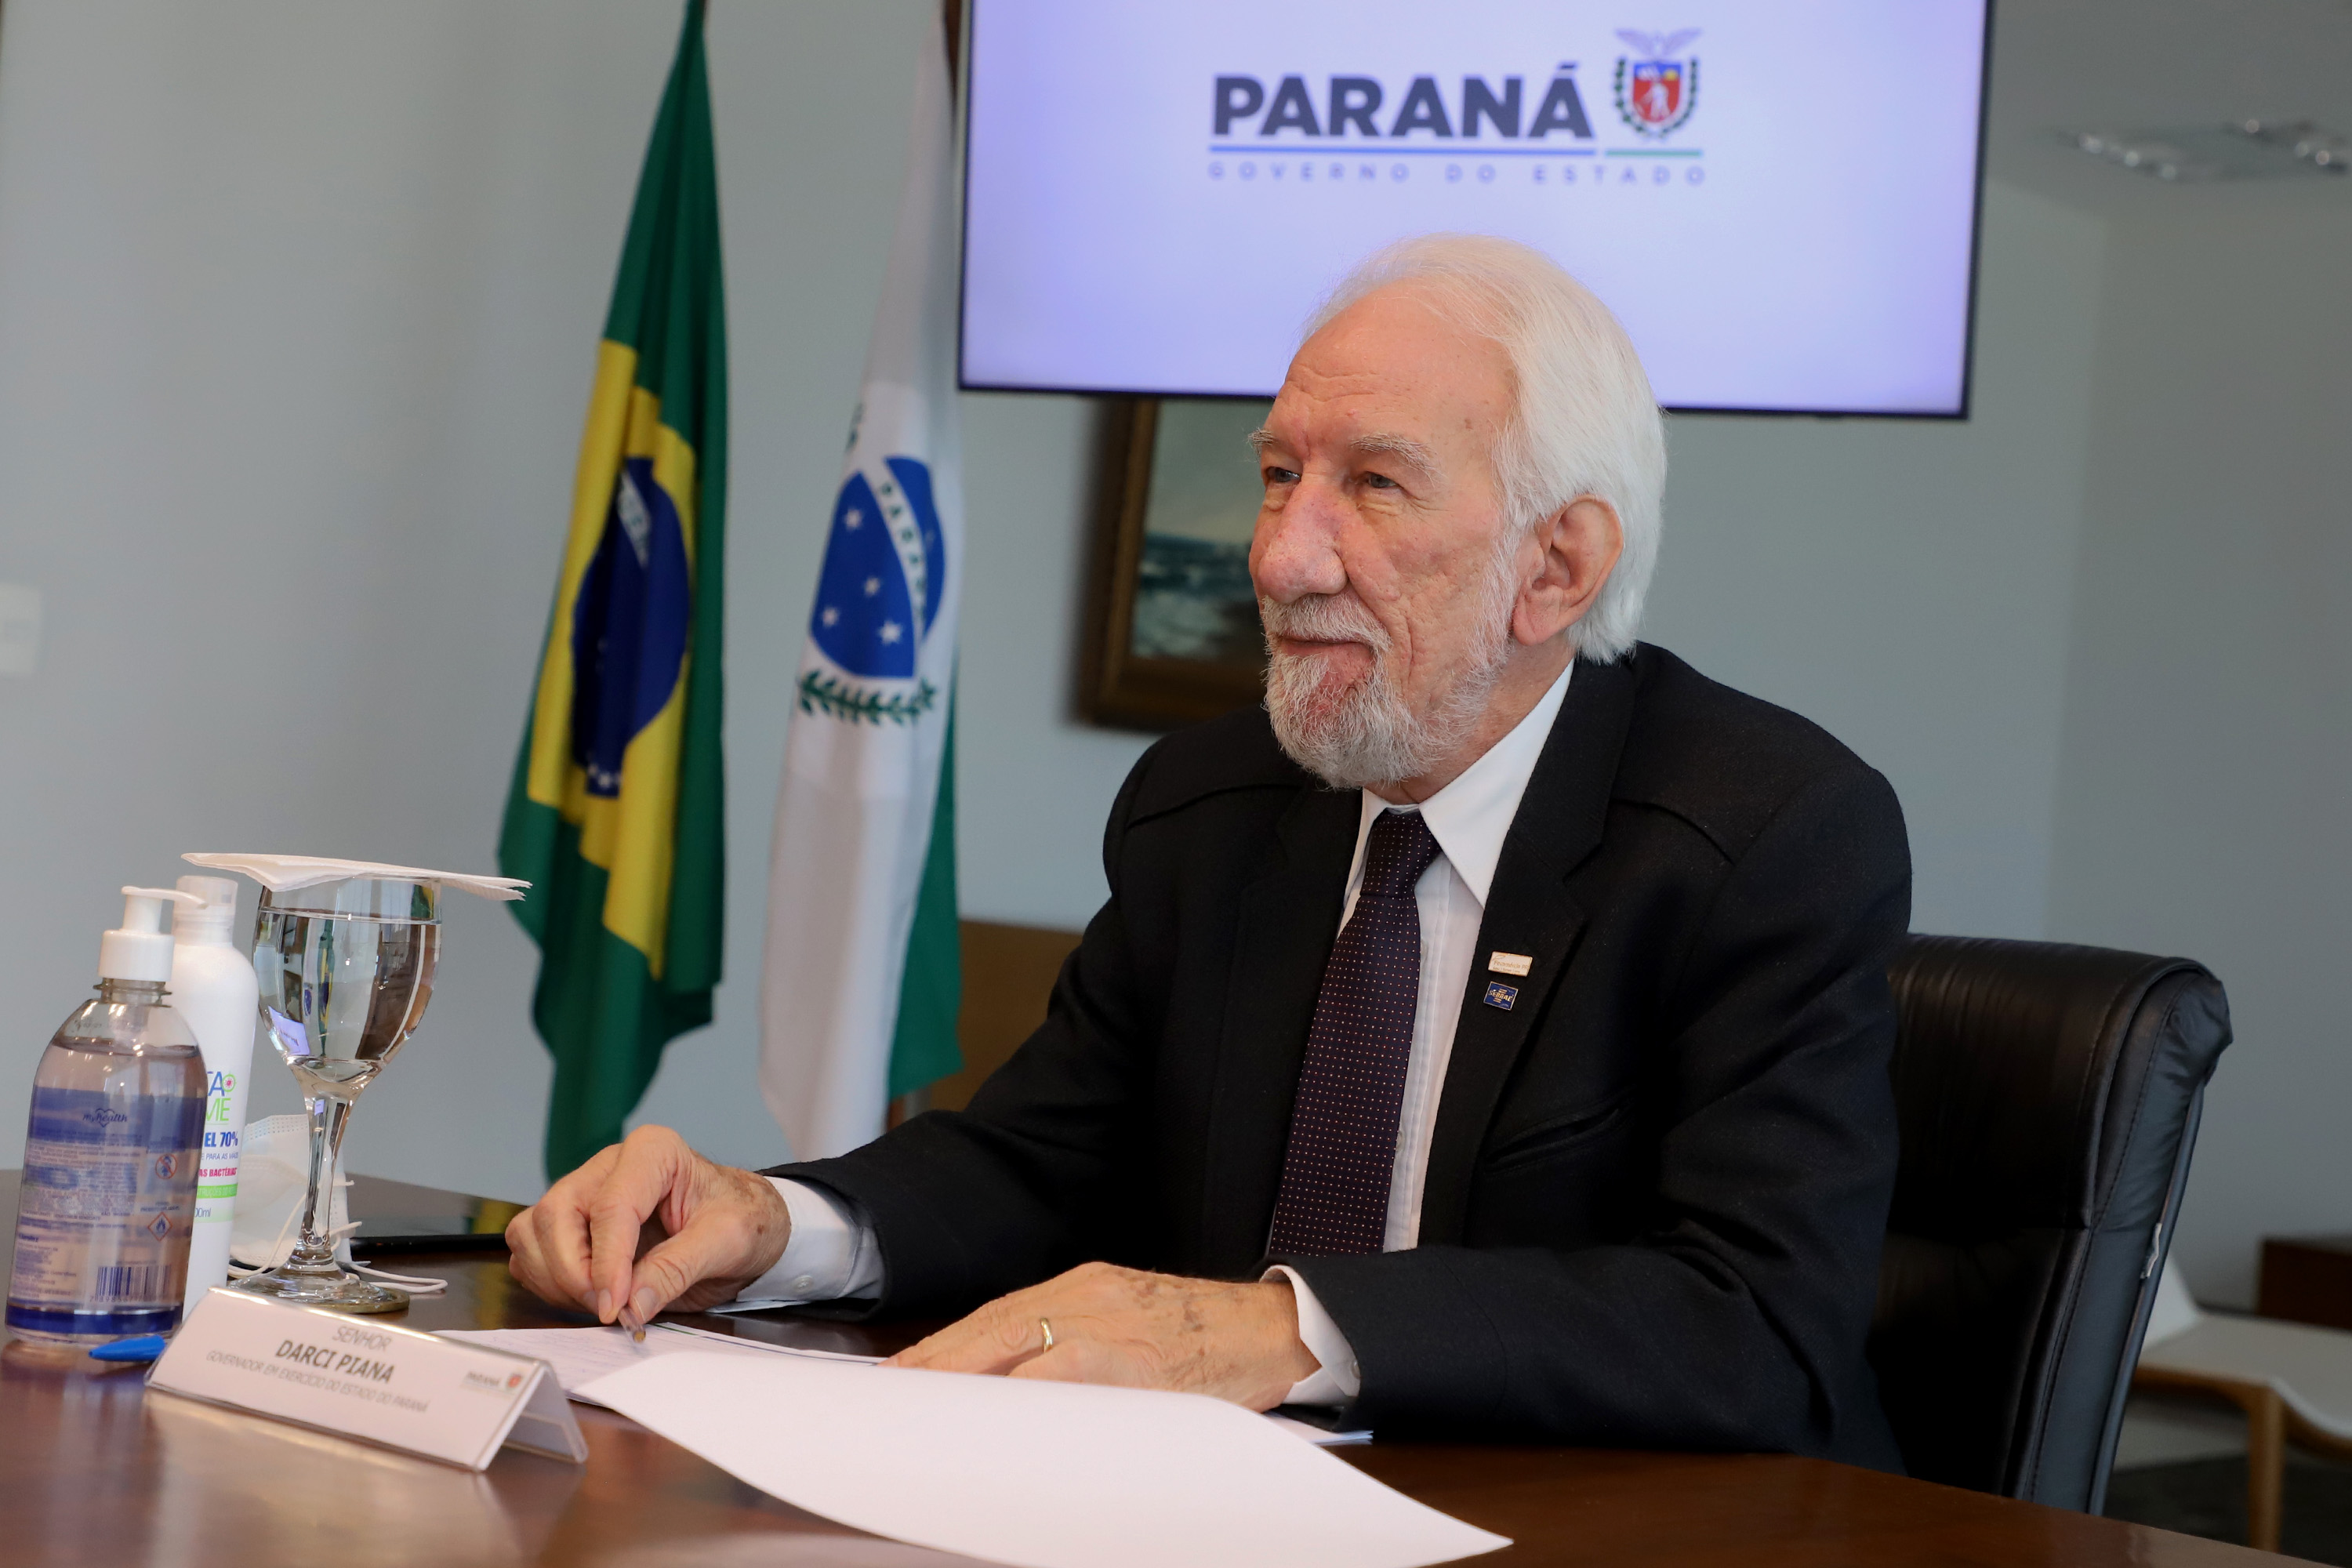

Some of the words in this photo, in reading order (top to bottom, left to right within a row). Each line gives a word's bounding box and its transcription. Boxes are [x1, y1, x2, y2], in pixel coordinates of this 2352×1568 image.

[1213, 62, 1594, 139] PARANÁ
[1208, 162, 1410, 182] GOVERNO
[1445, 164, 1496, 183] DO
[1533, 165, 1705, 186] ESTADO
[204, 1132, 216, 1147] EL
[220, 1131, 238, 1147] 70%
[333, 1326, 391, 1351] SENHOR
[206, 1350, 265, 1372] GOVERNADOR
[263, 1363, 279, 1377] EM
[325, 1378, 342, 1392] DO
[276, 1340, 336, 1369] DARCI
[336, 1355, 394, 1383] PIANA
